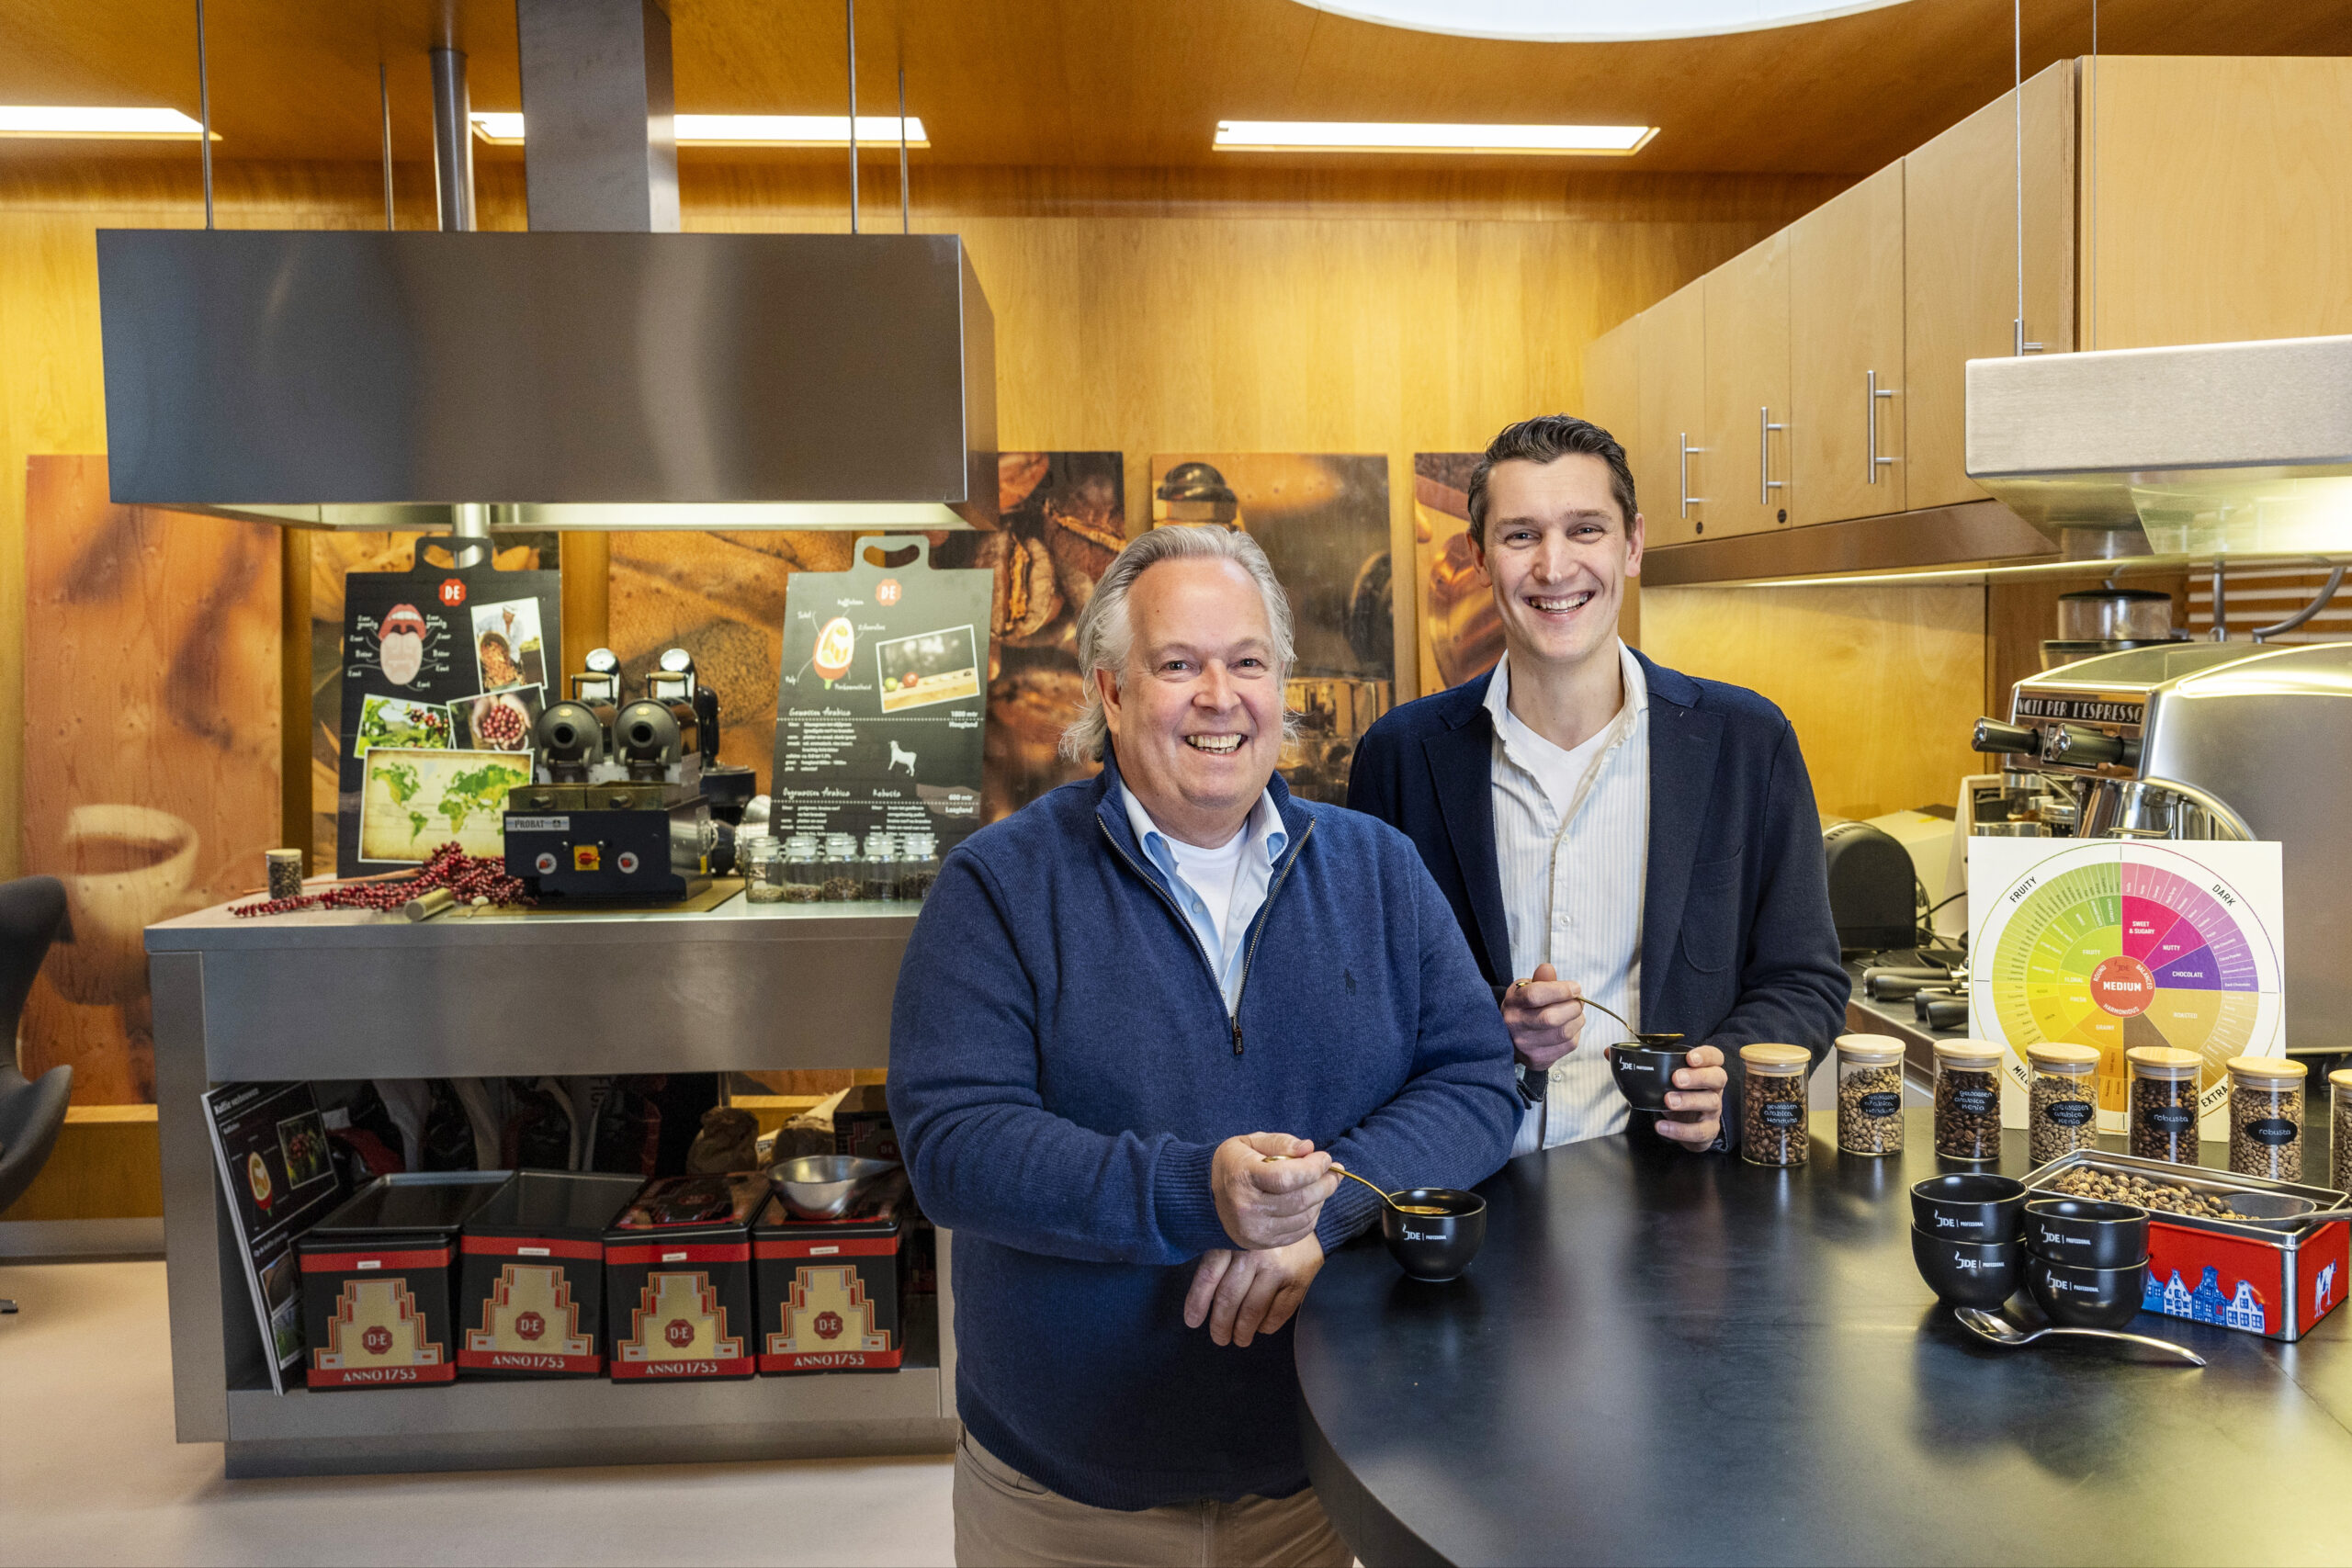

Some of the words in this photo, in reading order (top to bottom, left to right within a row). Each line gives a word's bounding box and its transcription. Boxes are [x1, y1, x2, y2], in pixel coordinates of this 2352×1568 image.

[2045, 700, 2068, 716] PER
[2073, 702, 2143, 722] L'ESPRESSO
[873, 788, 901, 798] Robusta
[514, 819, 545, 829] PROBAT
[2009, 875, 2037, 903] FRUITY
[2211, 884, 2236, 907] DARK
[2093, 964, 2108, 982] ROUND
[2135, 964, 2153, 990] BALANCED
[2172, 970, 2203, 978] CHOCOLATE
[2103, 981, 2142, 992] MEDIUM
[2103, 1003, 2140, 1015] HARMONIOUS
[1620, 1062, 1633, 1071] JDE
[2200, 1085, 2228, 1108] EXTRA
[2154, 1113, 2189, 1122] robusta
[2258, 1128, 2291, 1136] robusta
[1936, 1216, 1955, 1227] JDE
[1404, 1231, 1421, 1240] JDE
[2042, 1232, 2060, 1243] JDE
[1955, 1259, 1977, 1269] JDE
[2049, 1277, 2068, 1290] JDE
[492, 1355, 531, 1366] ANNO
[534, 1356, 565, 1369] 1753
[794, 1356, 833, 1368] ANNO
[835, 1354, 865, 1366] 1753
[646, 1363, 684, 1375] ANNO
[686, 1362, 718, 1374] 1753
[343, 1370, 382, 1382] ANNO
[385, 1369, 417, 1382] 1753
